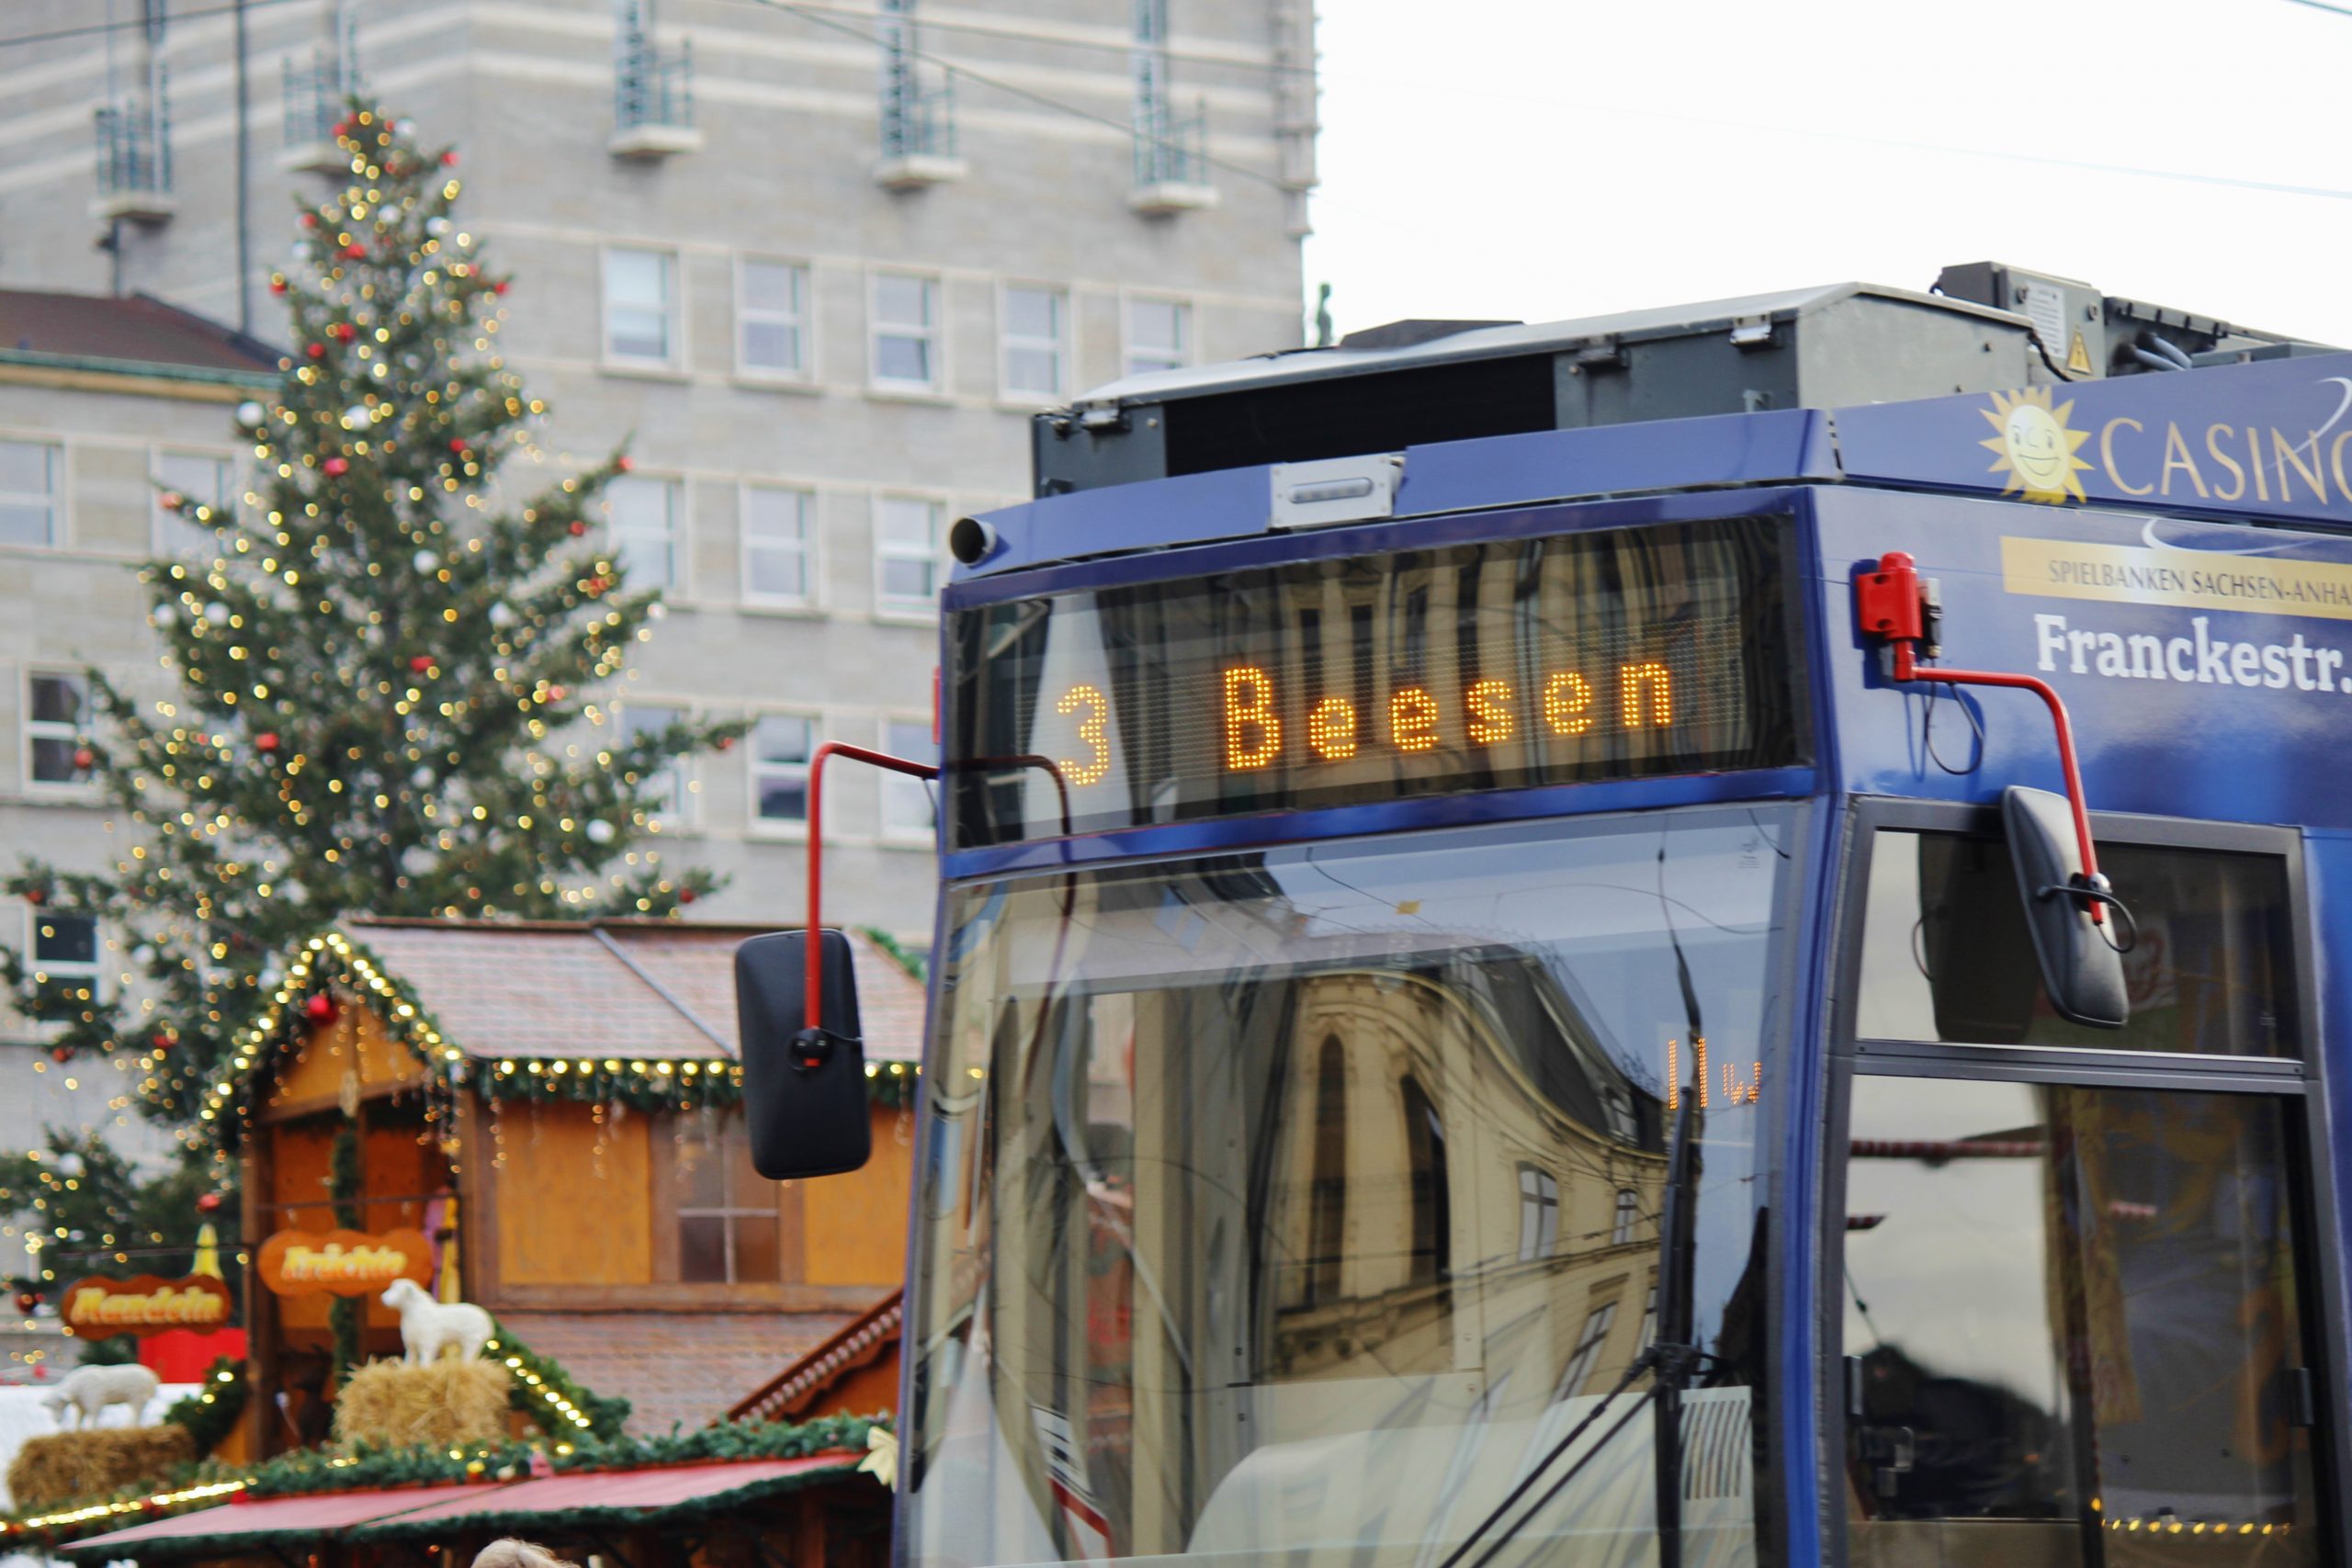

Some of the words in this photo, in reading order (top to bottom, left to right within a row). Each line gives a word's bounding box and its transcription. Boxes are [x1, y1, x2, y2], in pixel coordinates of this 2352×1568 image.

[2048, 558, 2187, 592] SPIELBANKEN
[2033, 613, 2352, 694] Franckestr.
[1057, 684, 1111, 786] 3
[1224, 661, 1673, 771] Beesen
